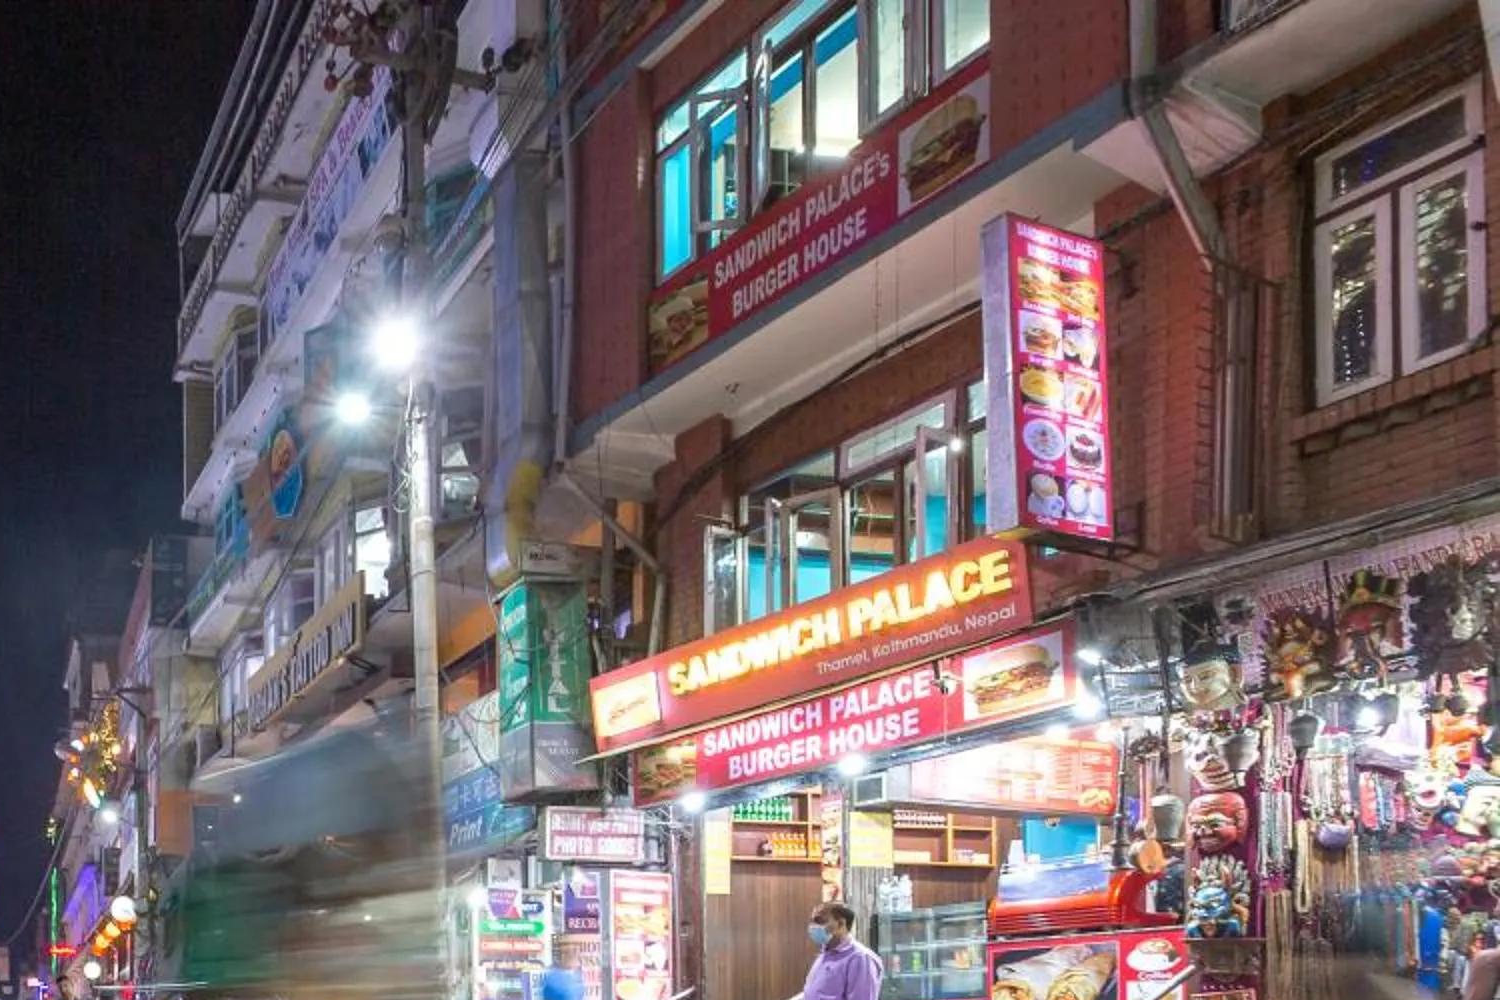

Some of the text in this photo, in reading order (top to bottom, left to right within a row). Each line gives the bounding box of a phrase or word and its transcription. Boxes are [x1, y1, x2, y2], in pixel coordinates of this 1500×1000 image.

[714, 210, 801, 290] SANDWICH
[732, 209, 868, 320] BURGER HOUSE
[291, 627, 332, 694] TATTOO
[667, 550, 1013, 698] SANDWICH PALACE
[817, 604, 1017, 678] Thamel, Kathmandu, Nepal
[703, 697, 823, 757] SANDWICH
[727, 714, 921, 783] BURGER HOUSE
